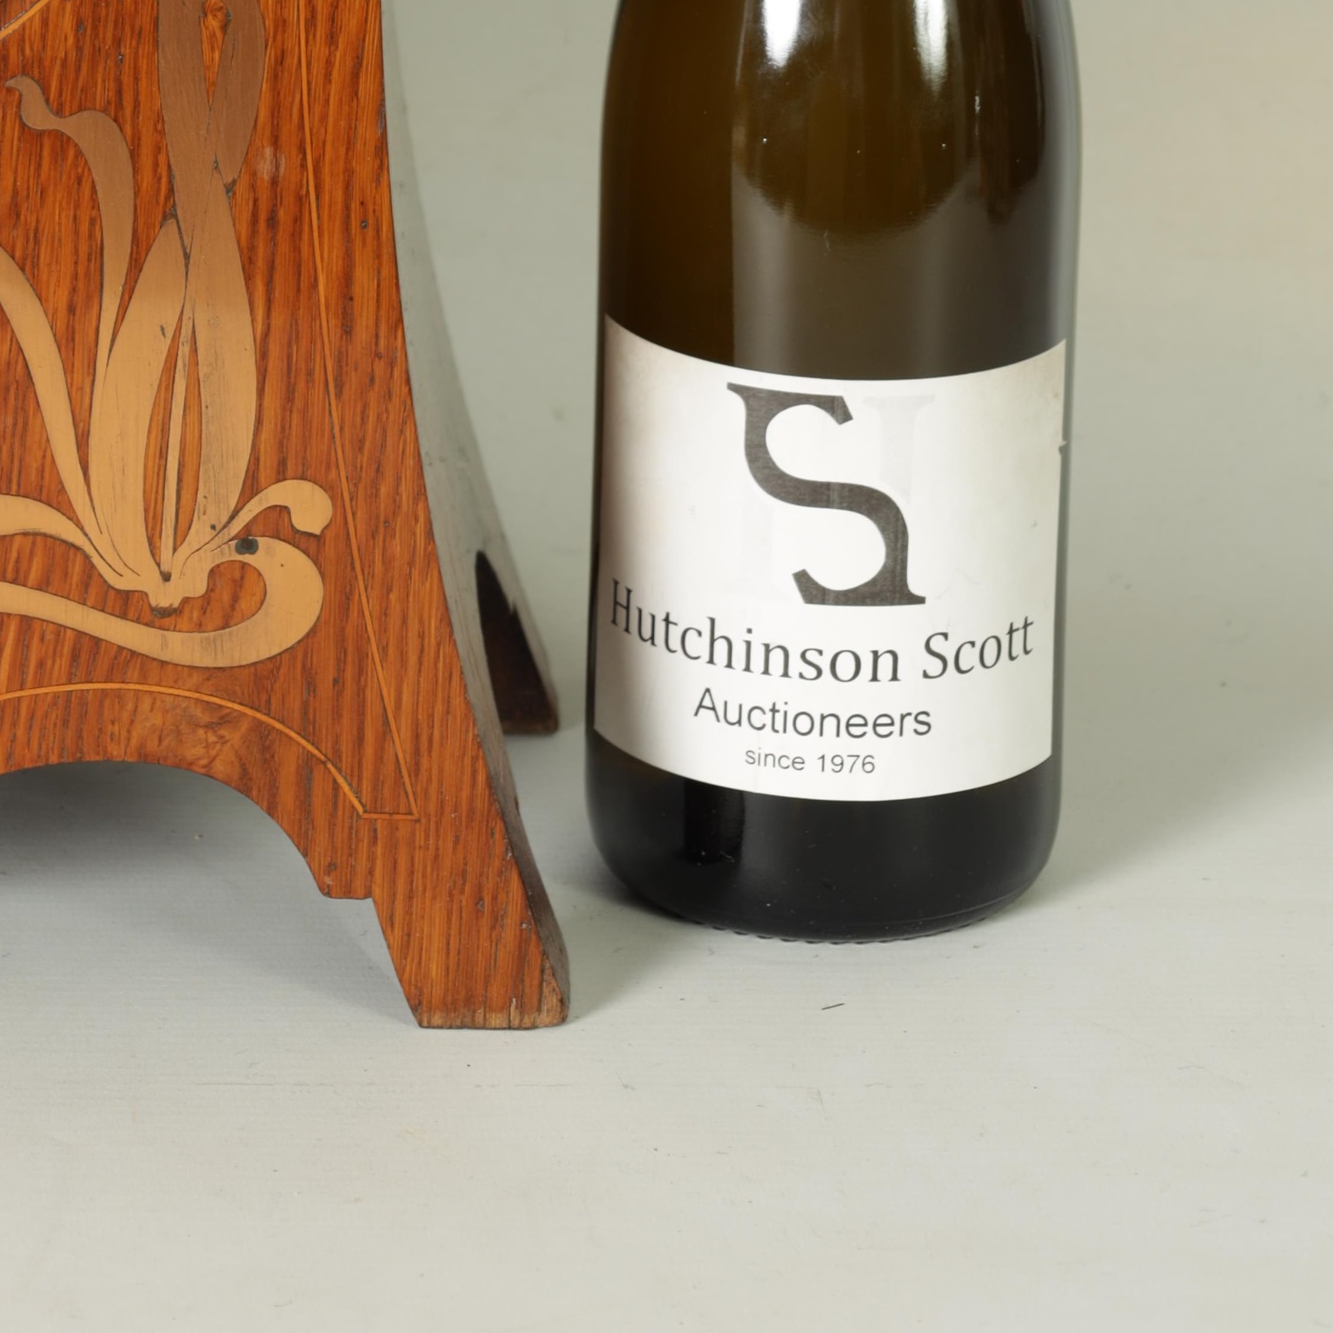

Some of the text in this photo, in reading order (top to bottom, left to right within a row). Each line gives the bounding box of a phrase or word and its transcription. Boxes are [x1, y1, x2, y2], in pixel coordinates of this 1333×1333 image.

[610, 578, 1035, 683] Hutchinson Scott
[693, 687, 933, 738] Auctioneers
[744, 747, 876, 774] since 1976
